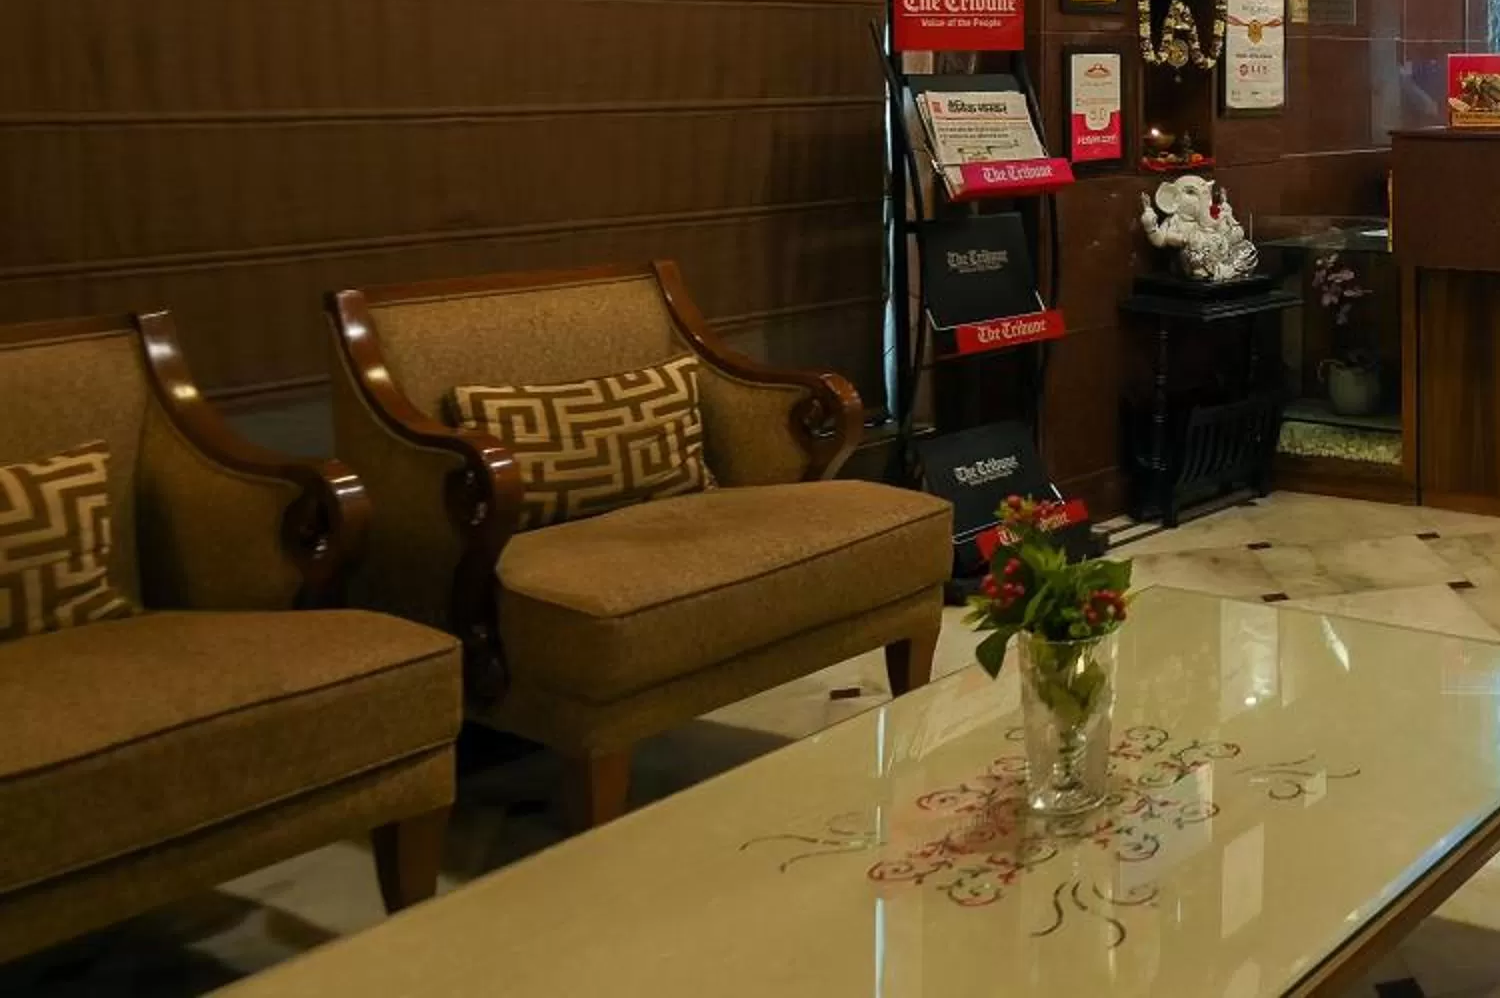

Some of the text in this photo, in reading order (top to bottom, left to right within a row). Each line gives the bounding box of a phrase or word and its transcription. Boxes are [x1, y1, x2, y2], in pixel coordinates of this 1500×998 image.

[981, 164, 1053, 183] The Tribune
[977, 319, 1047, 343] The Tribune
